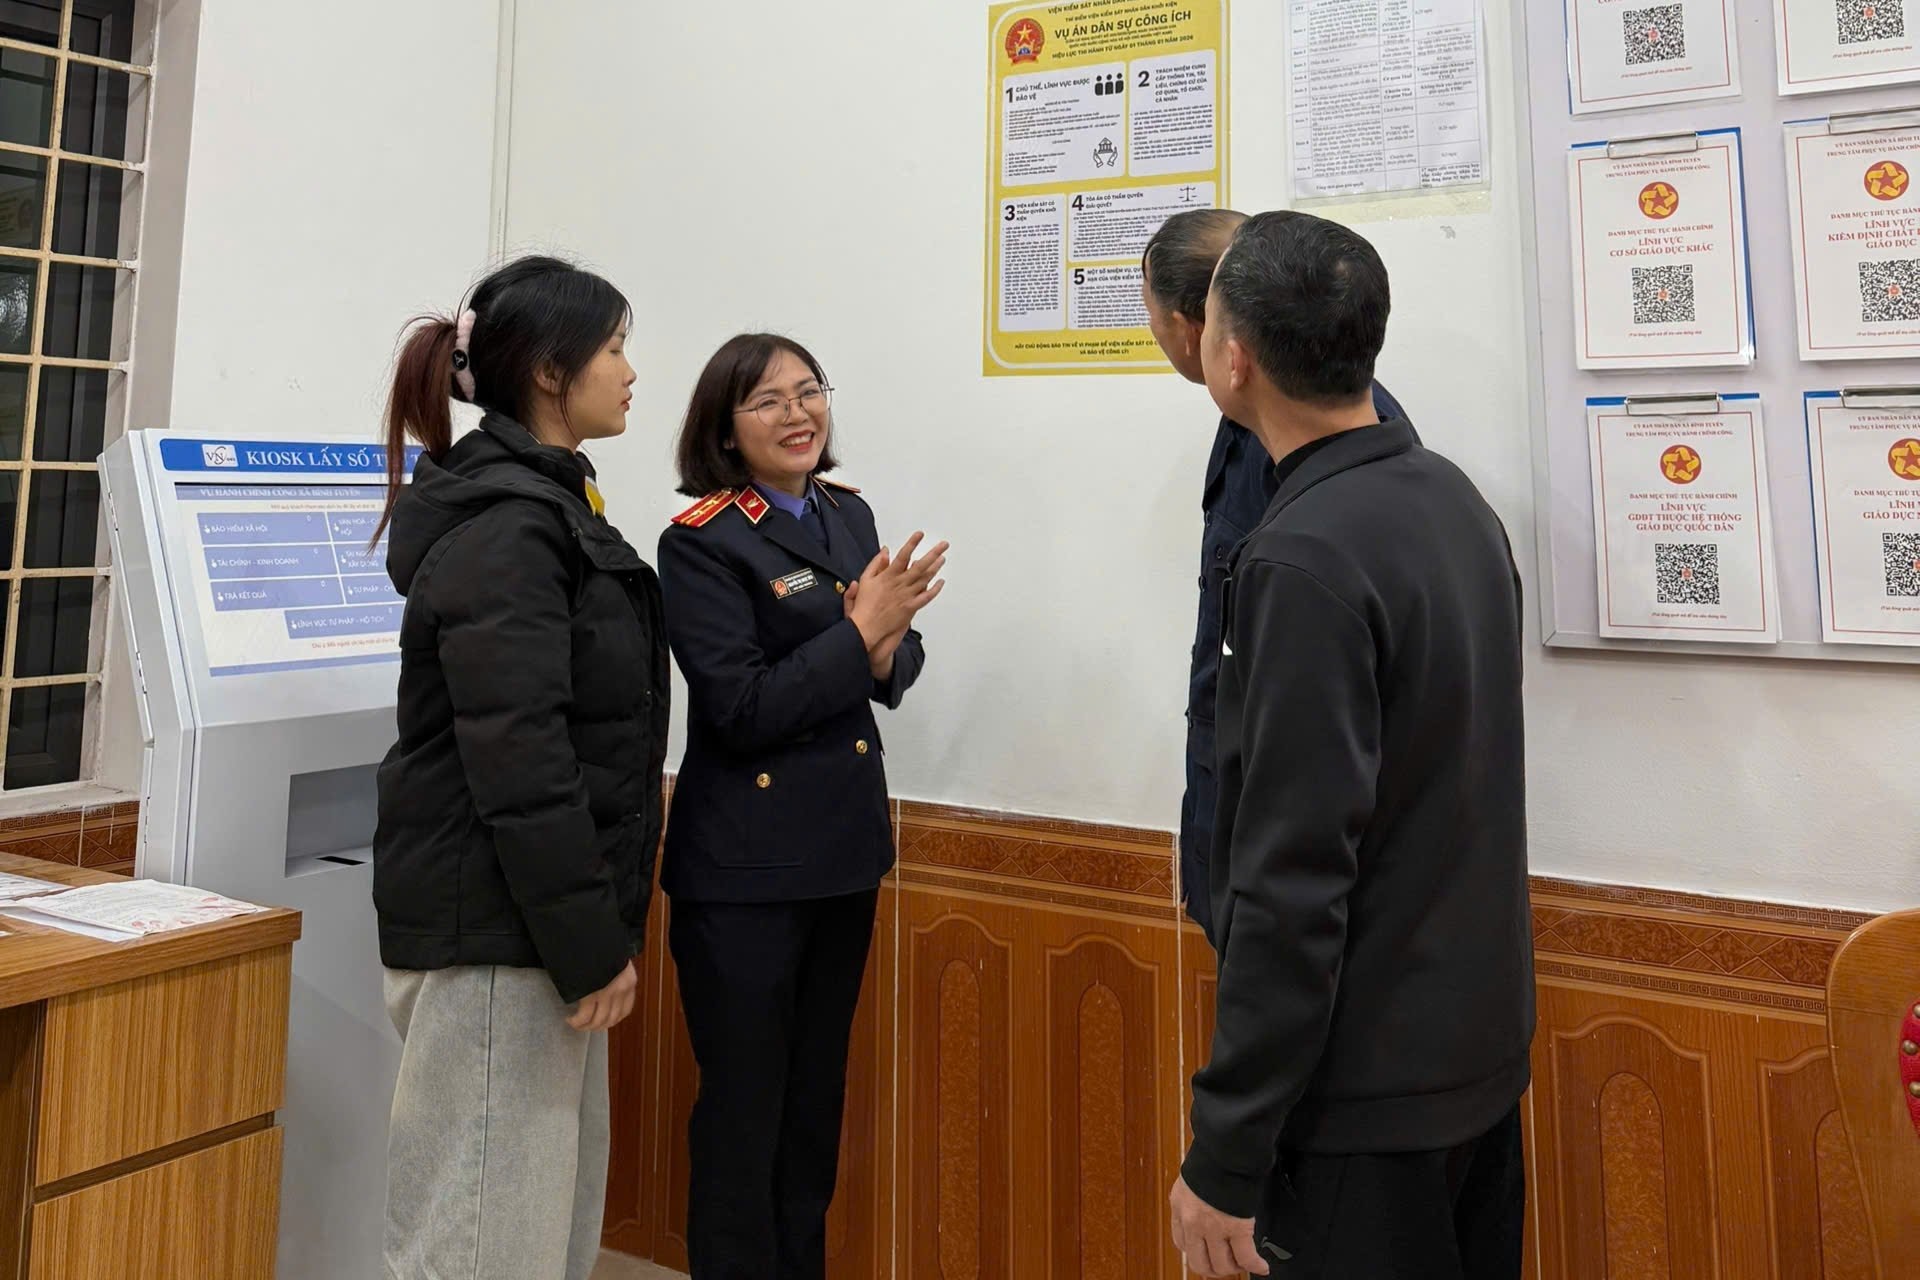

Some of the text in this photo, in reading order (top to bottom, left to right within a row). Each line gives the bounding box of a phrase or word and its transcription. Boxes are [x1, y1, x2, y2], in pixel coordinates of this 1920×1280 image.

[1055, 29, 1069, 40] VỤ
[1073, 24, 1087, 36] ÁN
[1091, 22, 1113, 33] DÂN
[1116, 18, 1133, 31] SỰ
[1136, 12, 1167, 27] CÔNG
[1171, 10, 1191, 21] ÍCH
[1138, 70, 1150, 88] 2
[1006, 87, 1013, 103] 1
[1072, 195, 1084, 211] 4
[1005, 205, 1015, 221] 3
[1865, 218, 1915, 230] LĨNH VỰC
[1639, 236, 1683, 246] LĨNH VỰC
[1866, 239, 1917, 249] GIÁO DỤC
[1610, 243, 1714, 257] CƠ SỞ GIÁO DỤC KHÁC
[1074, 268, 1085, 285] 5
[246, 450, 305, 466] KIOSK
[308, 446, 344, 467] LẤY
[350, 447, 370, 466] SỐ
[1661, 502, 1707, 512] LĨNH VỰC
[1889, 500, 1915, 509] LĨNH
[1657, 513, 1690, 522] THUỘC
[1692, 512, 1705, 522] HỆ
[1707, 511, 1742, 521] THỐNG
[1863, 510, 1914, 520] GIÁO DỤC
[1636, 520, 1734, 532] GIÁO DỤC QUỐC DÂN
